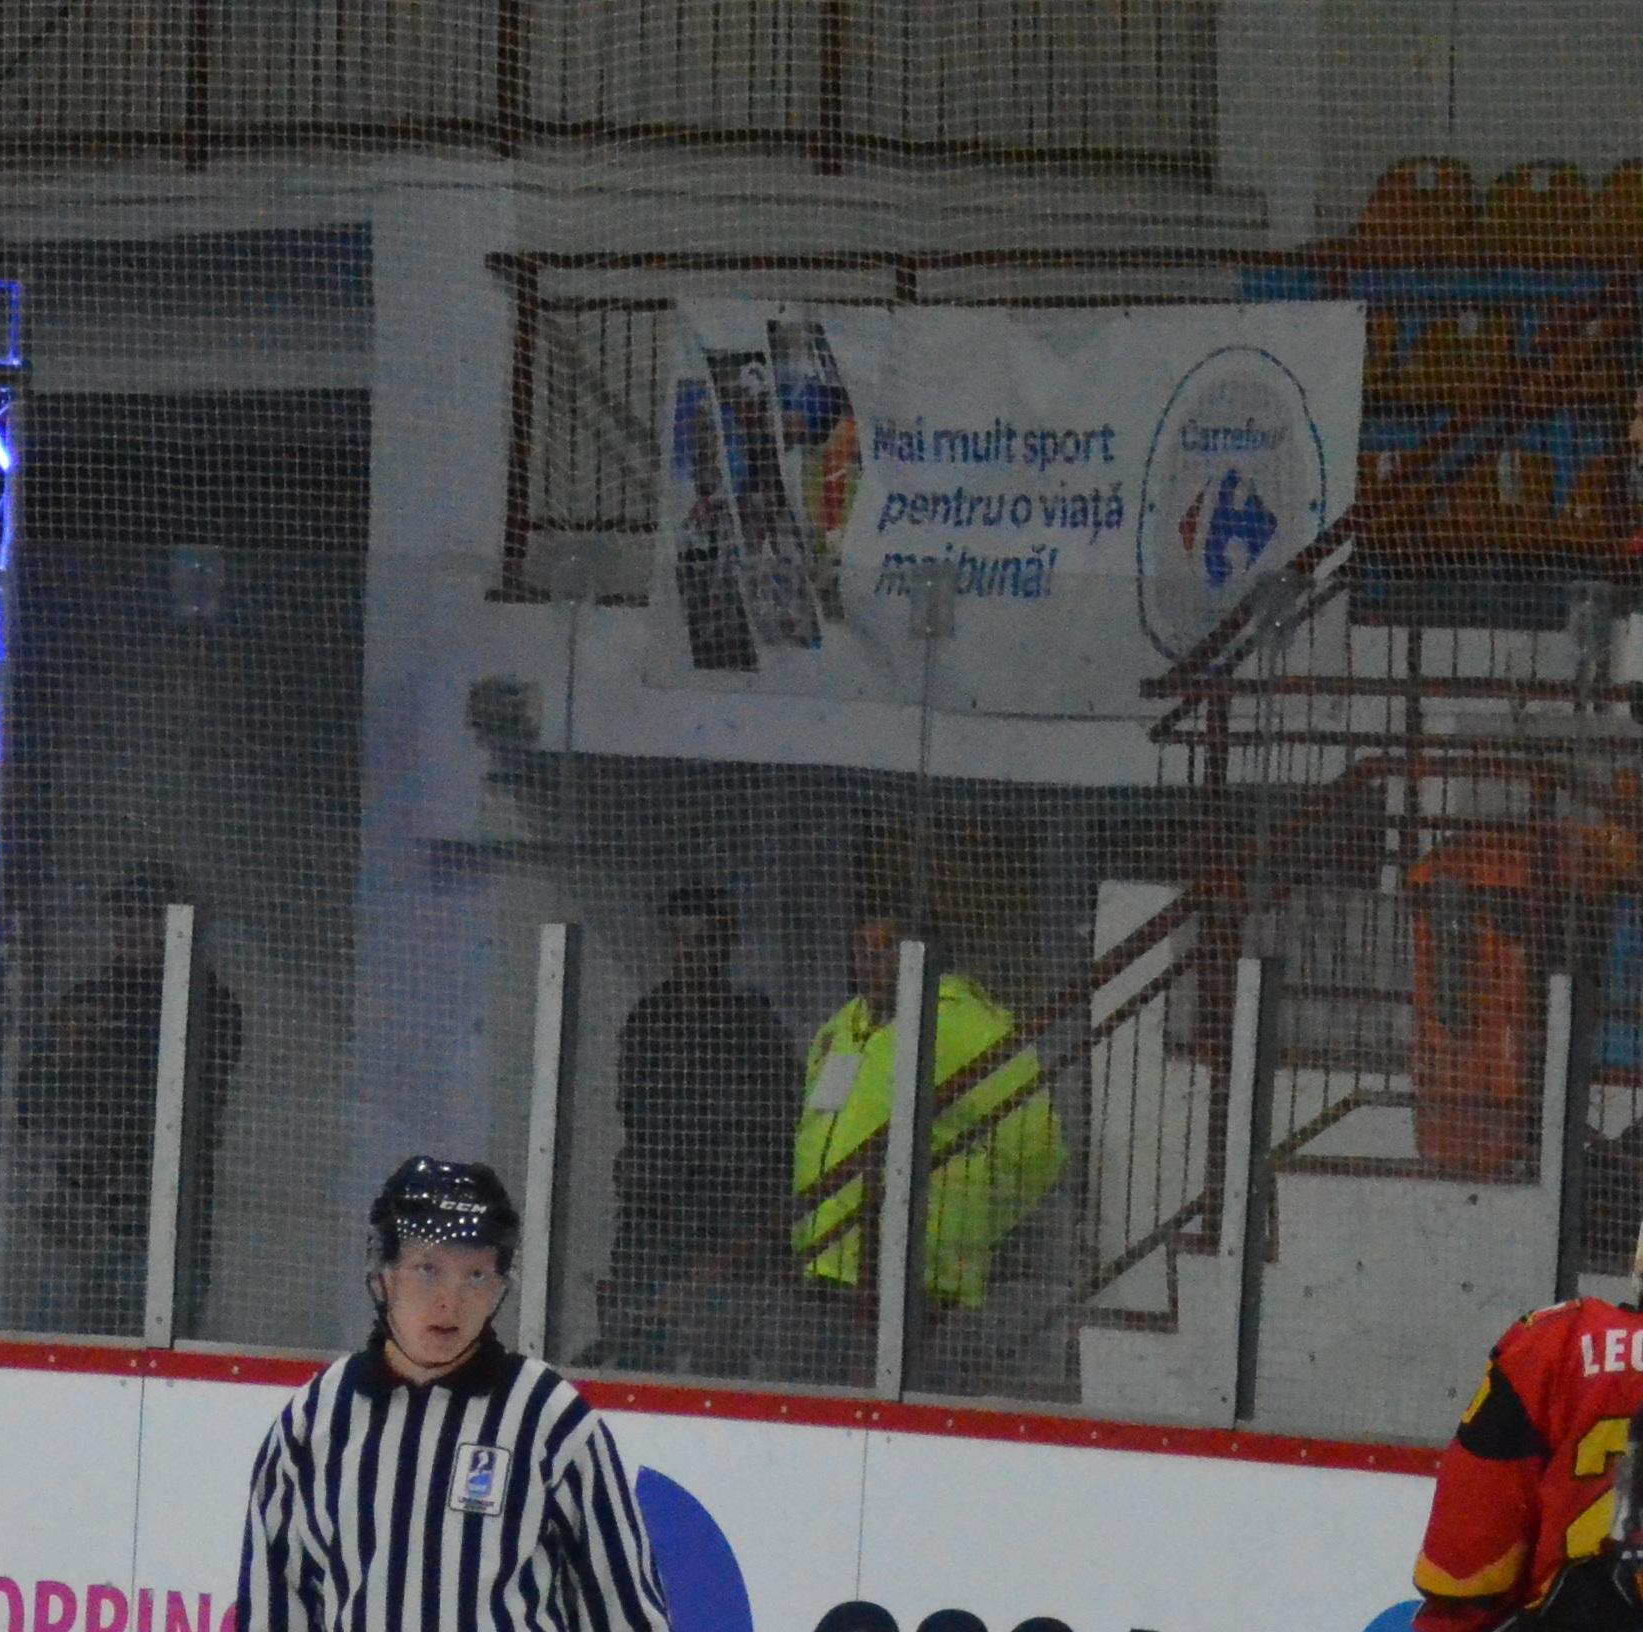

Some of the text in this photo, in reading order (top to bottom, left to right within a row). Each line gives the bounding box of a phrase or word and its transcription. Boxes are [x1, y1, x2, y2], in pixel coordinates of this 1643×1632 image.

[873, 416, 1115, 471] Mai mult sport
[877, 487, 1005, 533] pentru
[1012, 494, 1033, 524] o
[440, 1200, 487, 1215] CCM
